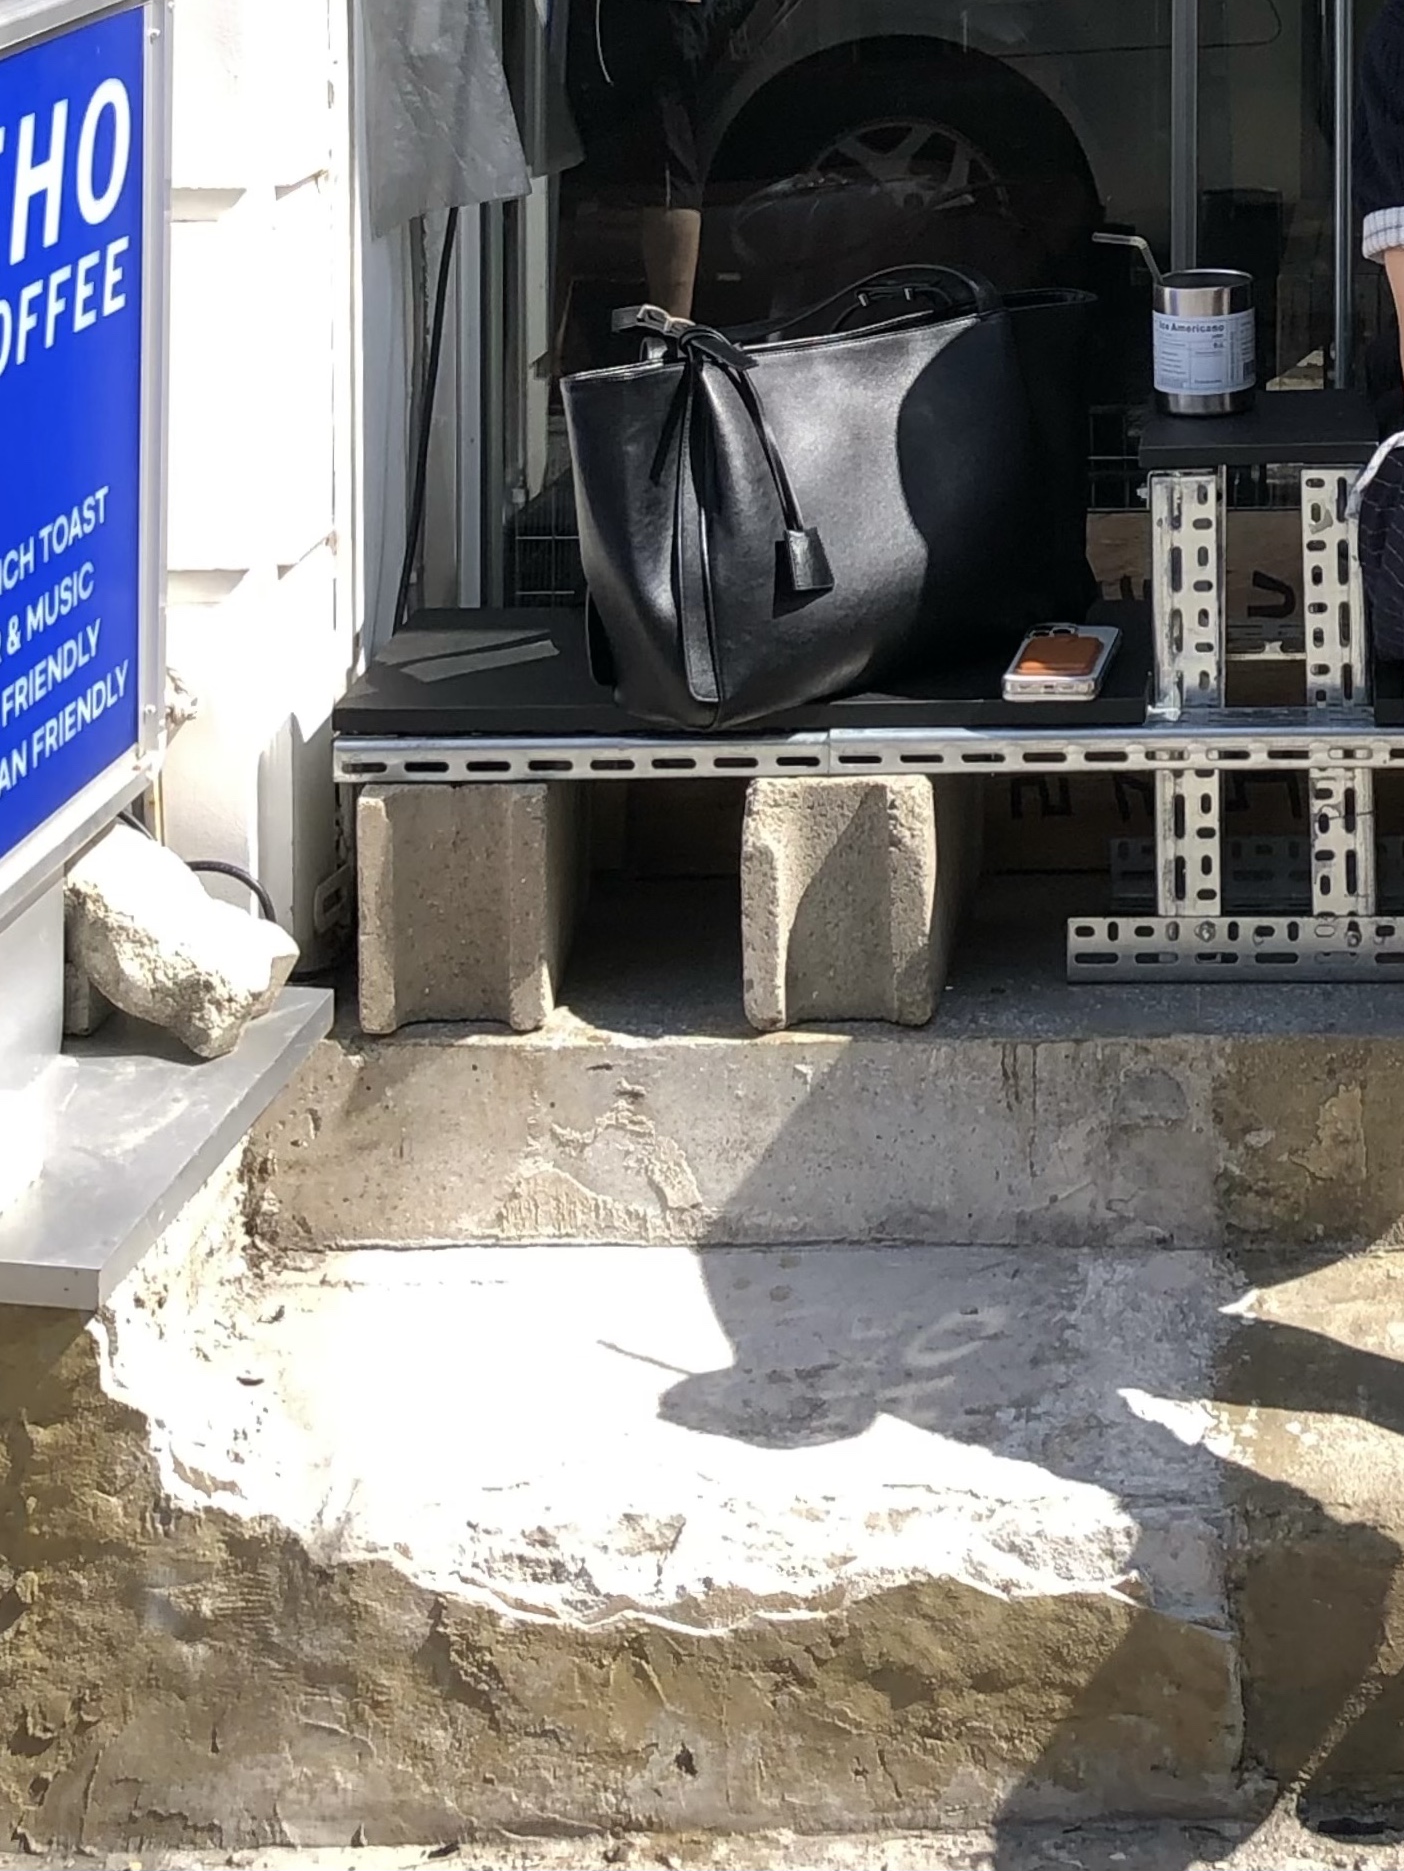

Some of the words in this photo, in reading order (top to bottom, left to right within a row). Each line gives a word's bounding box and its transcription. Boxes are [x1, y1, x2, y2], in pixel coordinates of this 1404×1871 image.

[0, 77, 131, 265] HO
[0, 536, 34, 596] CH
[39, 485, 109, 563] TOAST
[6, 614, 22, 656] &
[26, 561, 94, 642] MUSIC
[2, 617, 101, 728] FRIENDLY
[32, 658, 129, 769] FRIENDLY
